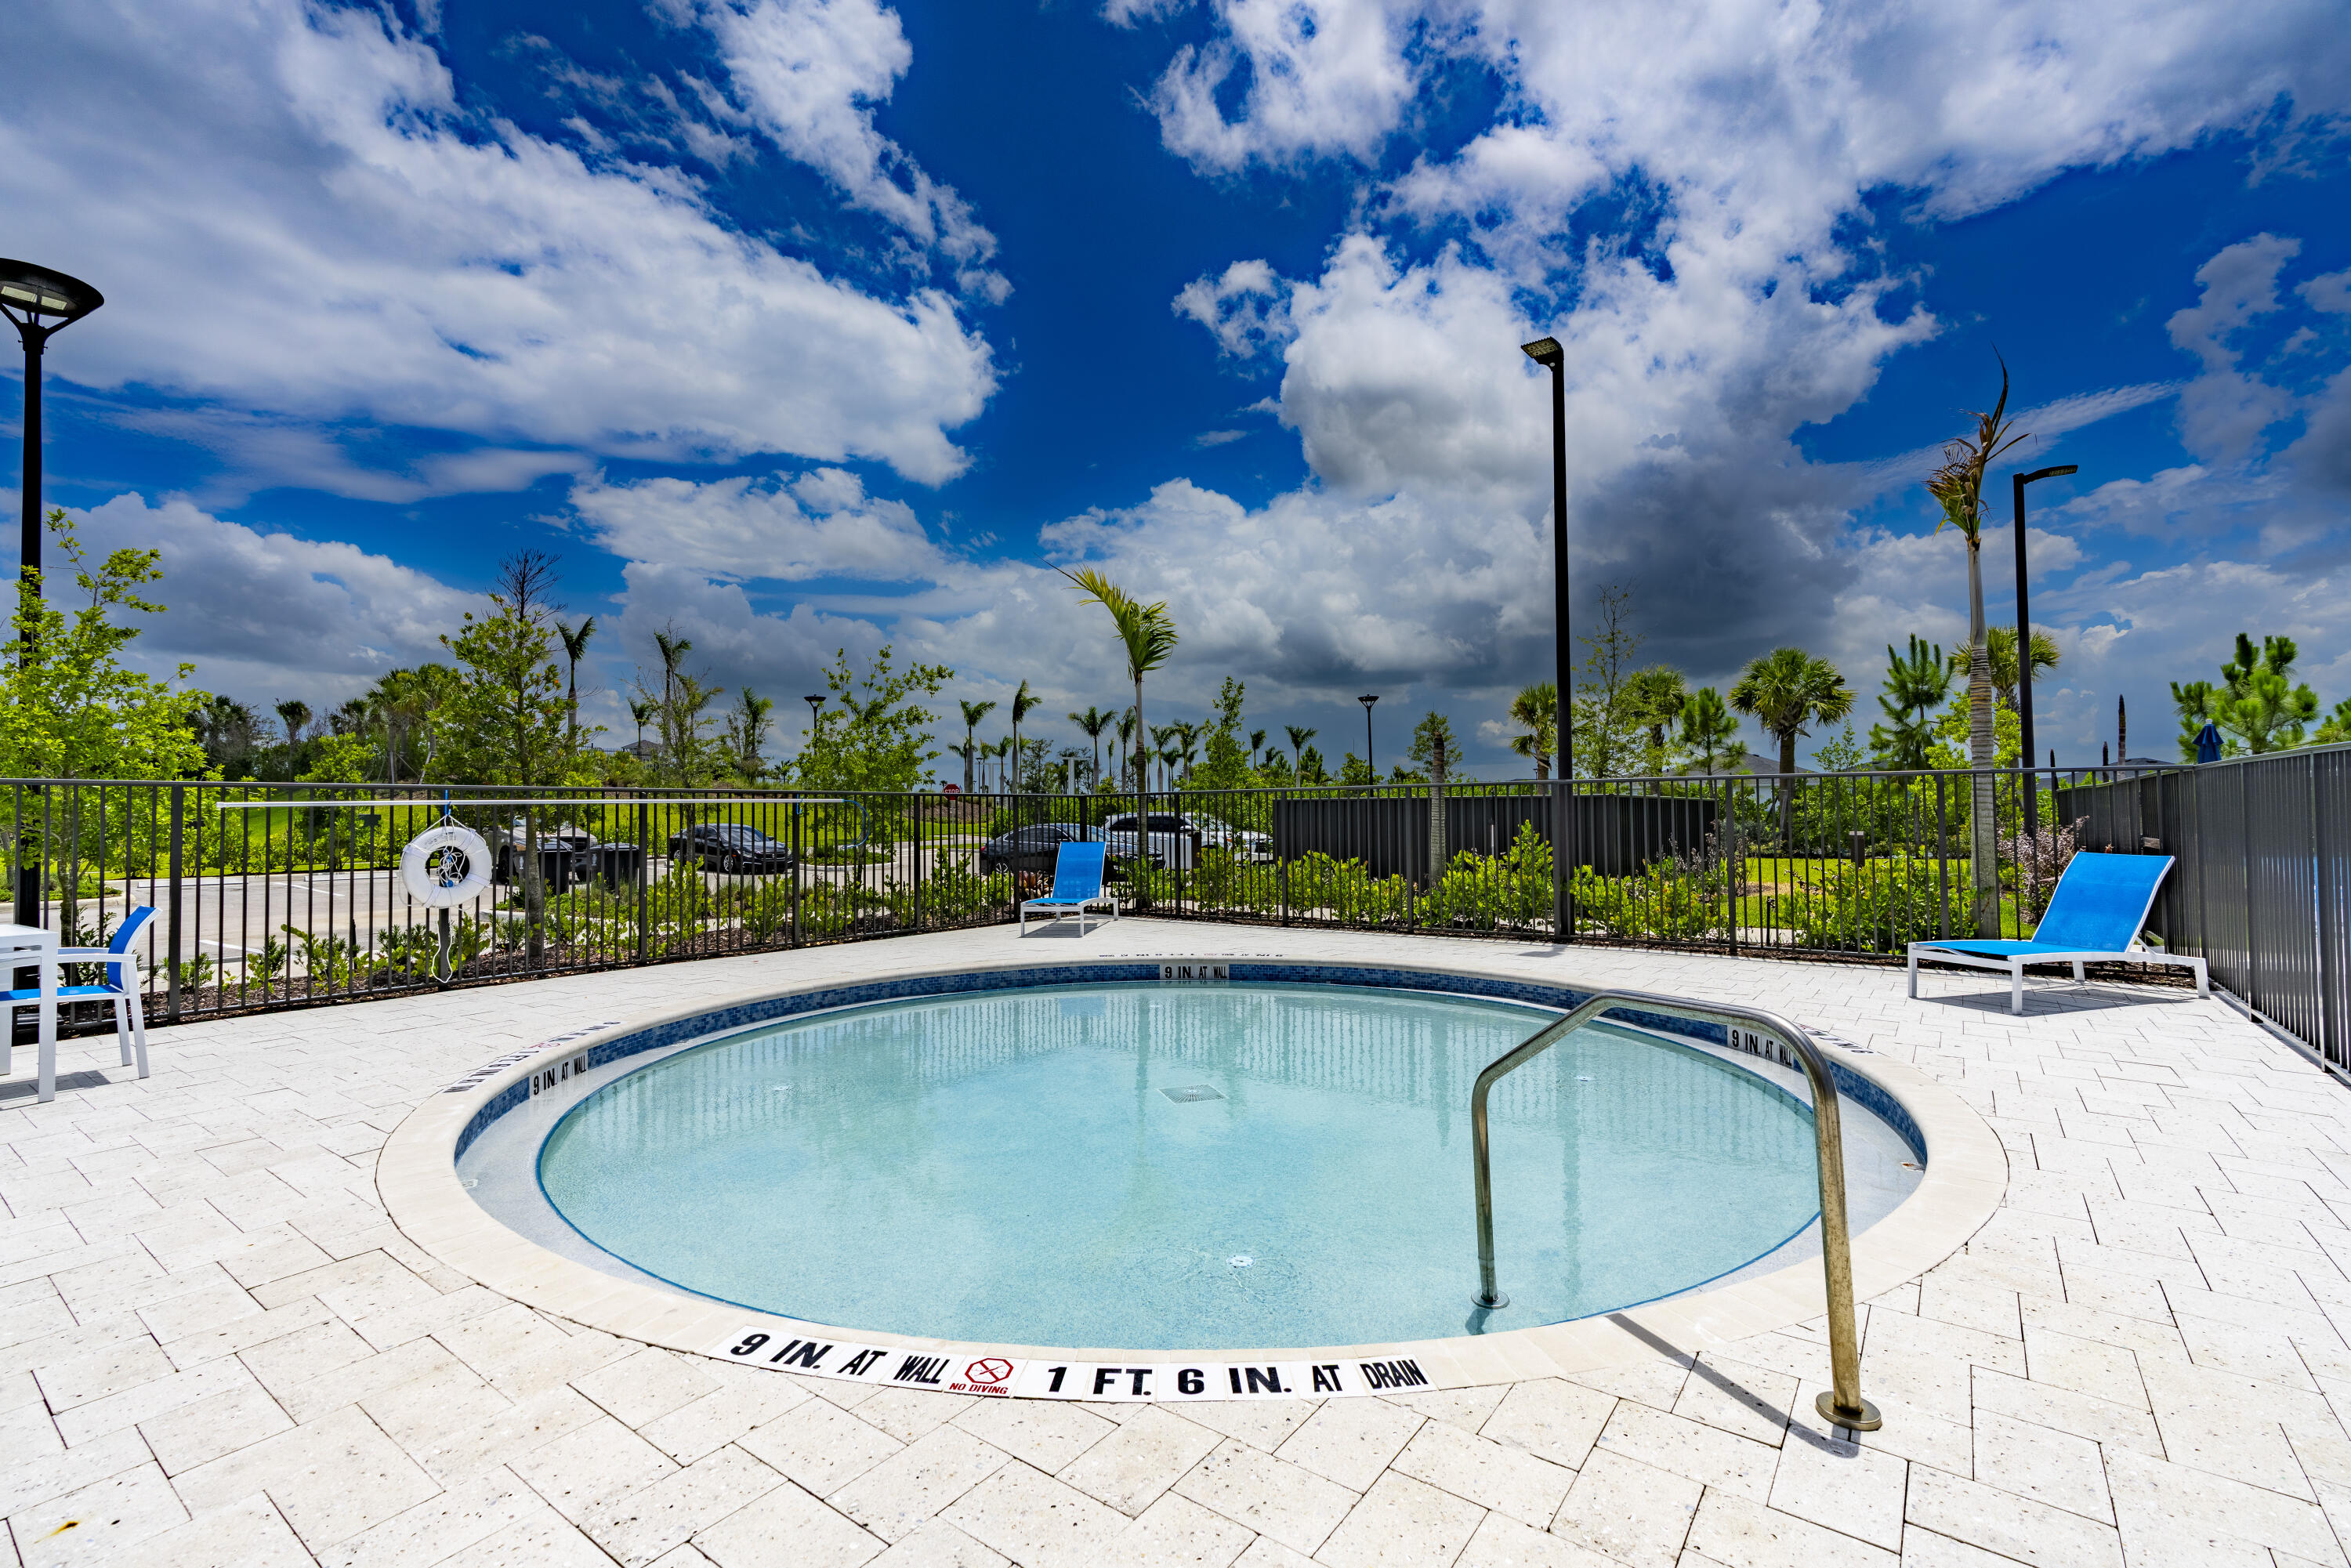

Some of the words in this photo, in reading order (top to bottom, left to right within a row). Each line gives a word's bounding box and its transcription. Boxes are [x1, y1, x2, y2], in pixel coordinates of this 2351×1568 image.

[1165, 966, 1172, 979] 9
[1178, 966, 1194, 979] IN.
[1198, 966, 1208, 979] AT
[1213, 966, 1227, 979] WALL
[1731, 1030, 1740, 1048] 9
[1744, 1033, 1761, 1055] IN.
[1765, 1039, 1773, 1059] AT
[1778, 1044, 1792, 1066] WALL
[533, 1075, 540, 1095] 9
[543, 1068, 557, 1090] IN.
[561, 1061, 569, 1082] AT
[574, 1055, 587, 1077] WALL
[730, 1333, 770, 1356] 9
[769, 1339, 834, 1370] IN.
[836, 1349, 888, 1376] AT
[893, 1355, 951, 1385] WALL
[1047, 1366, 1067, 1392] 1
[1092, 1367, 1153, 1396] FT.
[1177, 1368, 1205, 1395] 6
[1227, 1366, 1292, 1394] IN.
[1311, 1364, 1343, 1393] AT
[1359, 1358, 1429, 1389] DRAIN
[949, 1382, 966, 1391] NO
[968, 1383, 1009, 1395] DIVING
